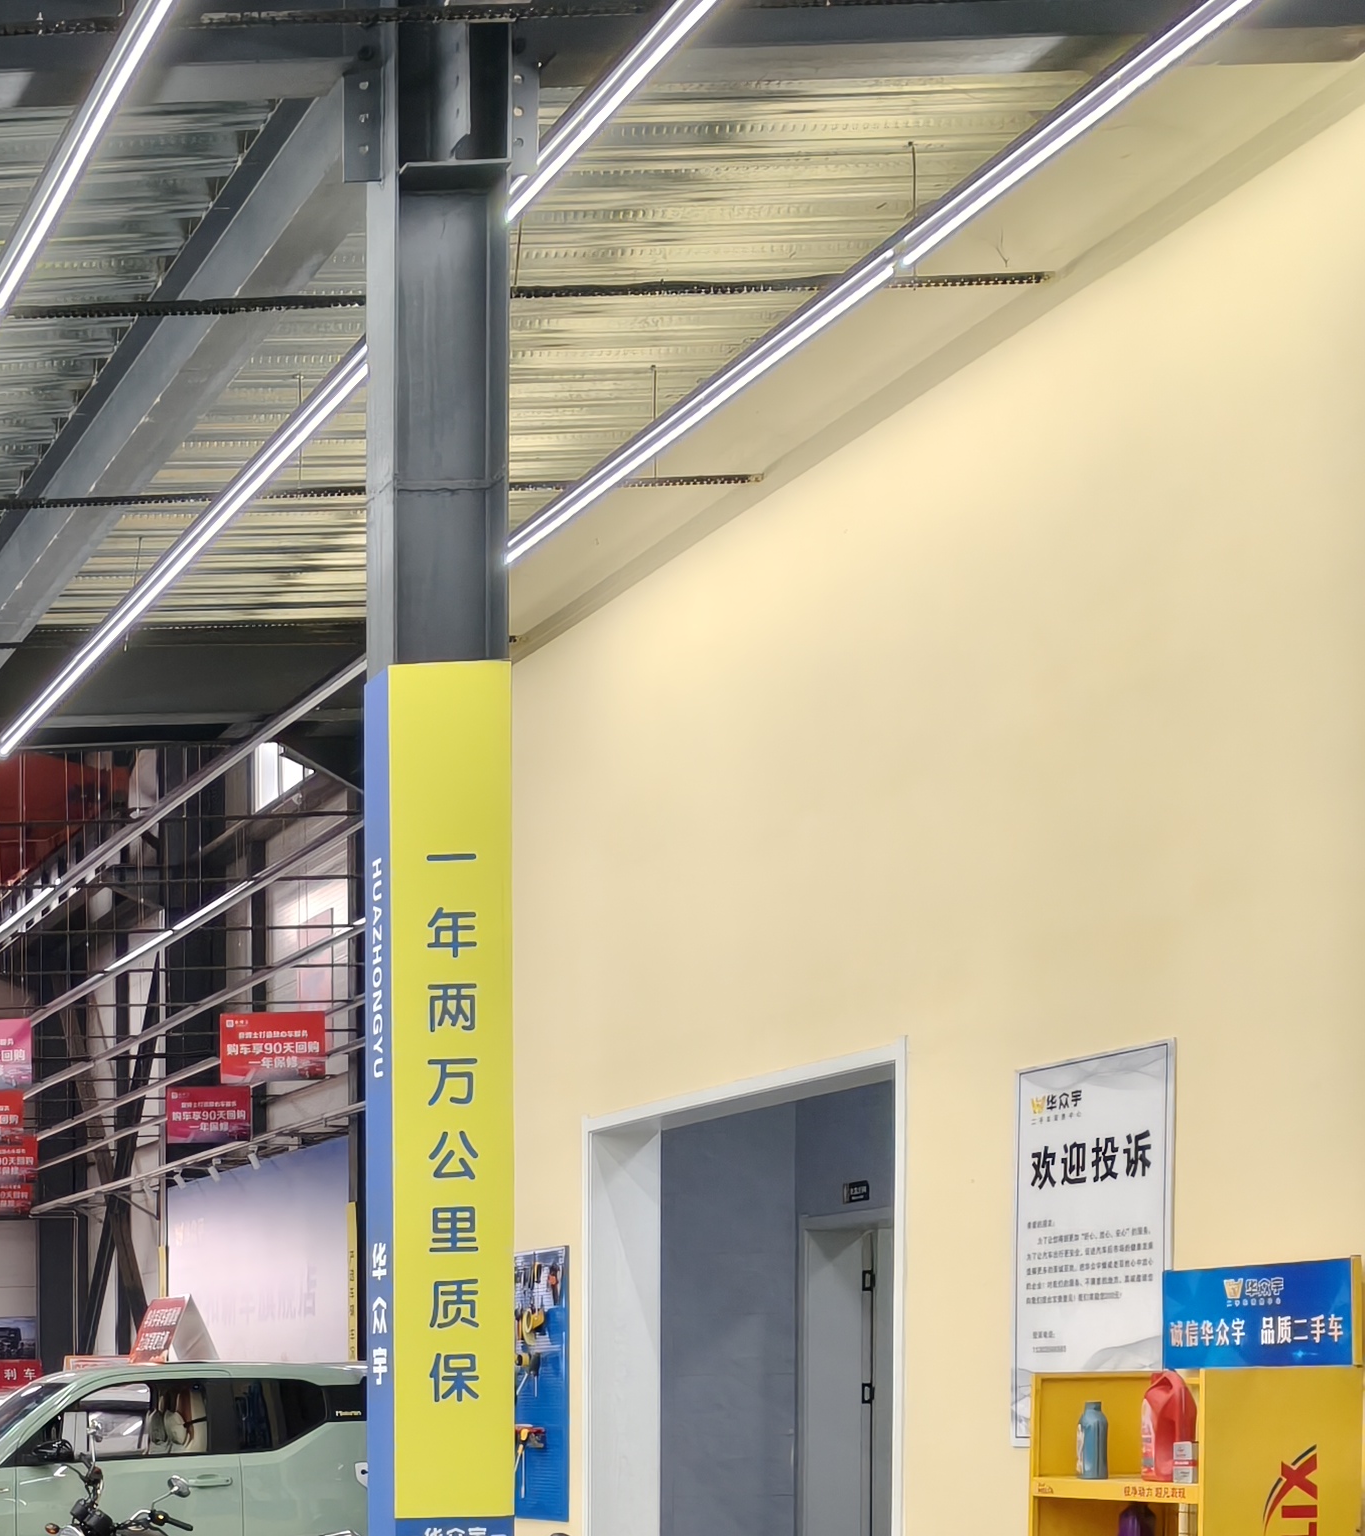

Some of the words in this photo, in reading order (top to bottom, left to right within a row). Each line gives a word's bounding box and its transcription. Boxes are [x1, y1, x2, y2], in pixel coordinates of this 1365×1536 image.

[371, 857, 384, 1079] HUAZHONGYU
[226, 1041, 320, 1056] 购车享90天回购
[248, 1056, 298, 1069] 一年保修
[1046, 1090, 1082, 1110] 华众宇
[172, 1110, 246, 1121] 购车享90天回购
[425, 853, 481, 1404] 一年两万公里质保
[1030, 1129, 1152, 1190] 欢迎投诉
[1245, 1277, 1284, 1297] 华众宇
[371, 1241, 388, 1387] 华众宇
[1170, 1318, 1246, 1348] 诚信华众宇
[1260, 1314, 1344, 1346] 品质二手车
